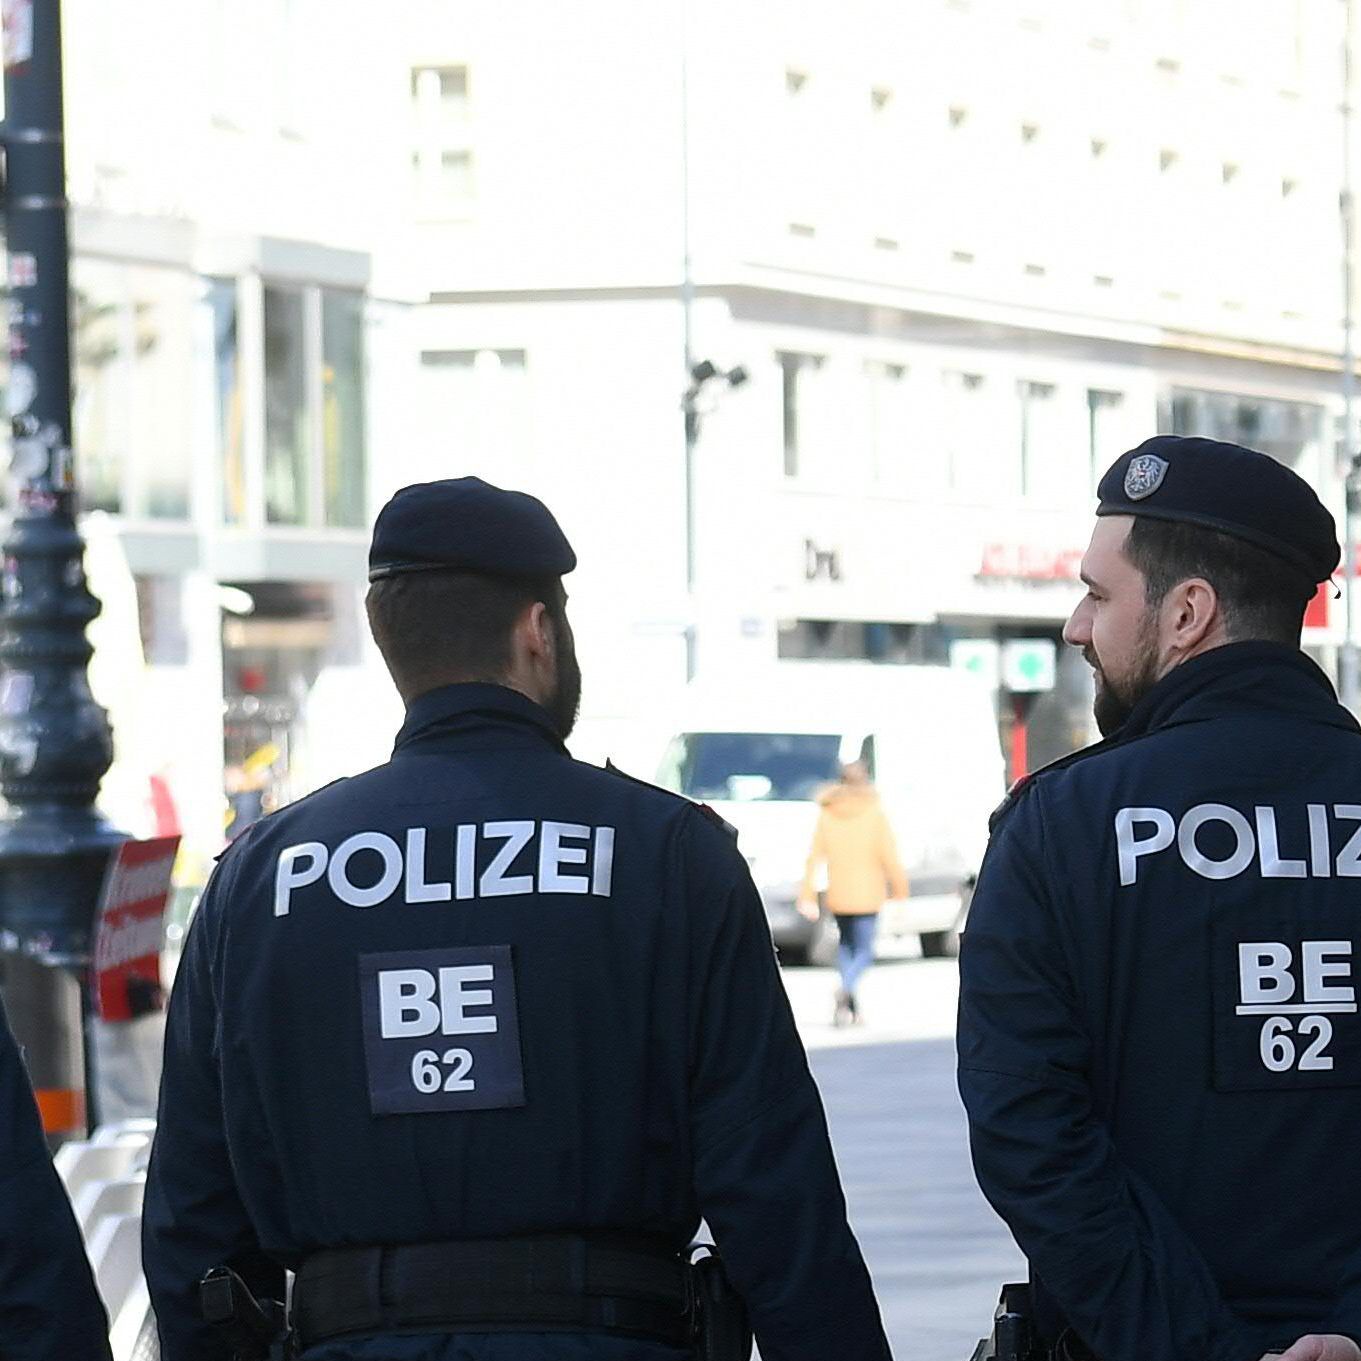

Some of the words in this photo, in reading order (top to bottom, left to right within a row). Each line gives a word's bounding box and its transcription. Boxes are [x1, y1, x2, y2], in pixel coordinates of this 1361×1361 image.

[273, 819, 616, 918] POLIZEI
[377, 963, 499, 1040] BE
[1237, 939, 1356, 1005] BE
[410, 1047, 476, 1095] 62
[1259, 1014, 1335, 1073] 62
